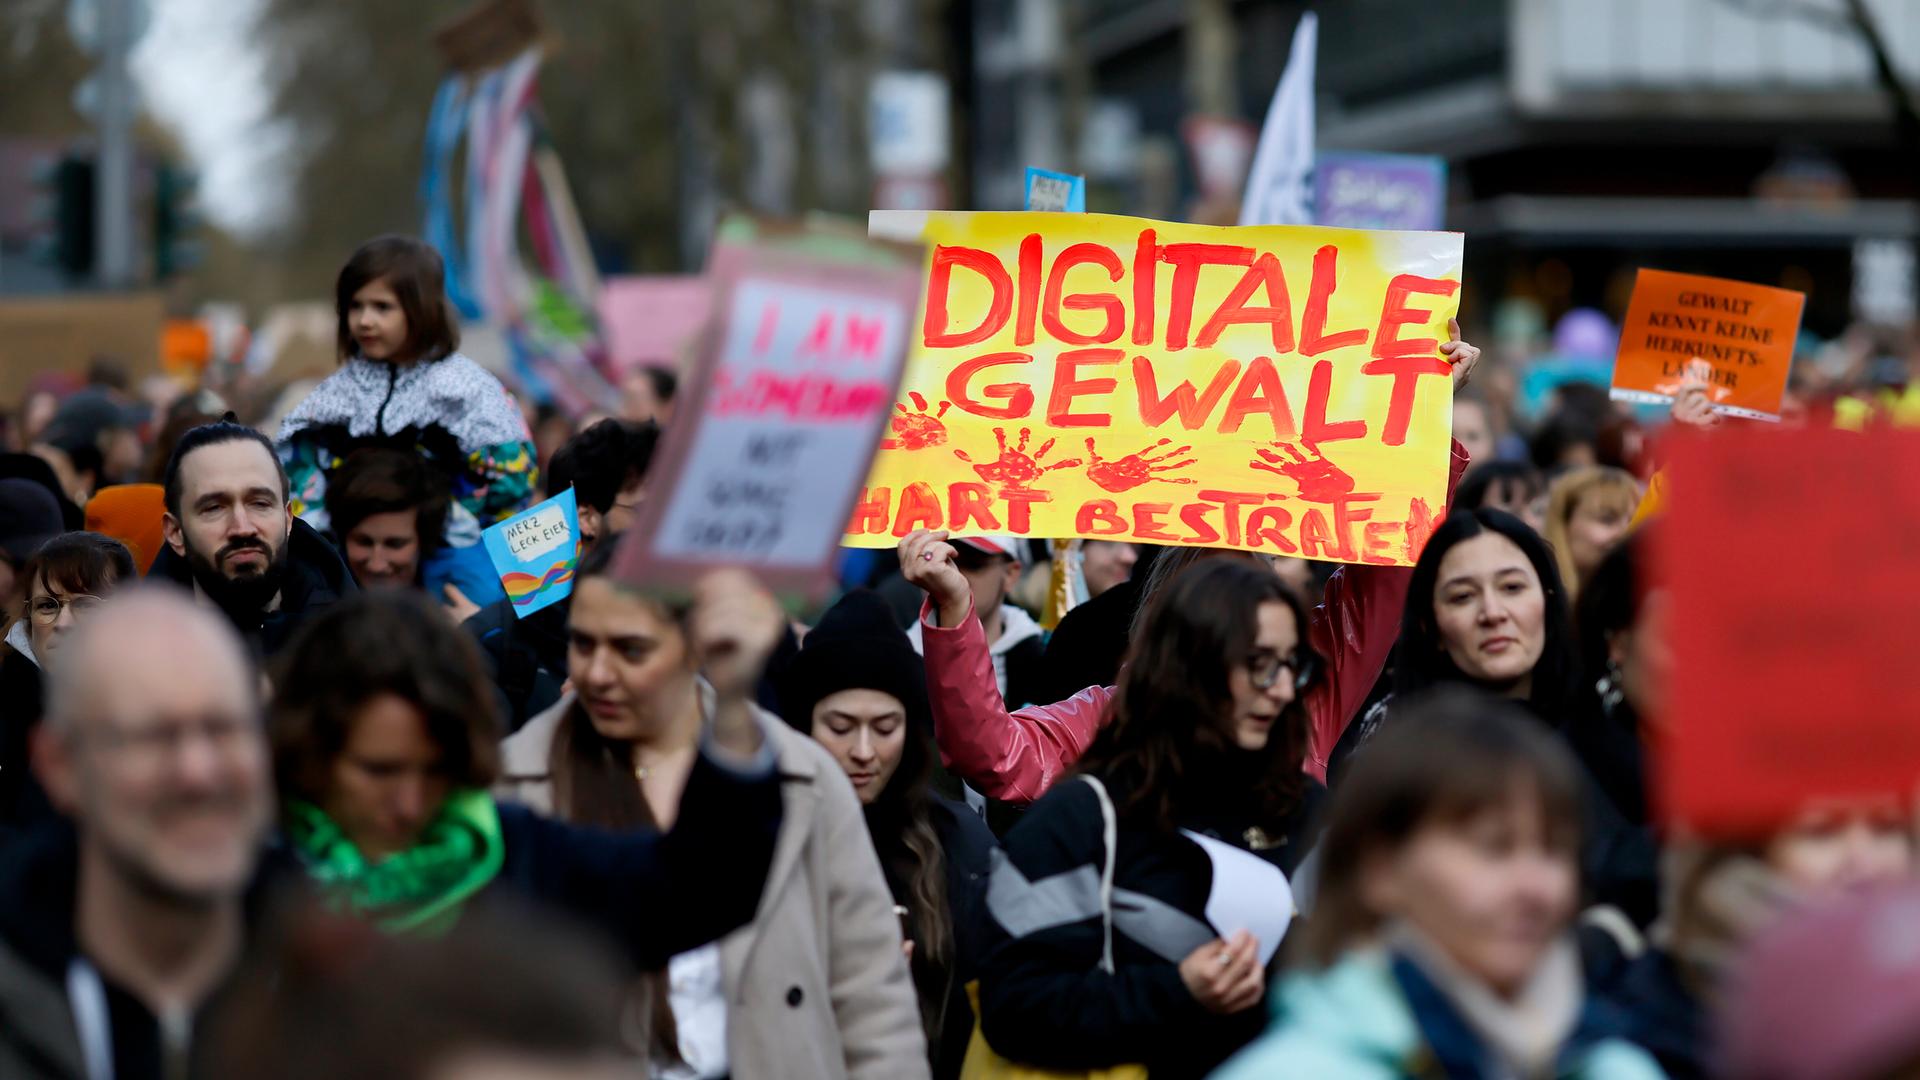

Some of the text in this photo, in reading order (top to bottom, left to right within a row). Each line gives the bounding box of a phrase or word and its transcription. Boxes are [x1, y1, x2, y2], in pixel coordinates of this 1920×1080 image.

[923, 229, 1461, 358] DIGITALE
[1678, 290, 1752, 316] GEWALT
[1648, 311, 1775, 346] KENNT KEINE
[1645, 334, 1767, 367] HERKUNFTS-
[945, 348, 1454, 446] GEWALT
[845, 481, 1054, 537] HART
[507, 516, 540, 540] MERZ
[510, 521, 571, 553] LECK EIER
